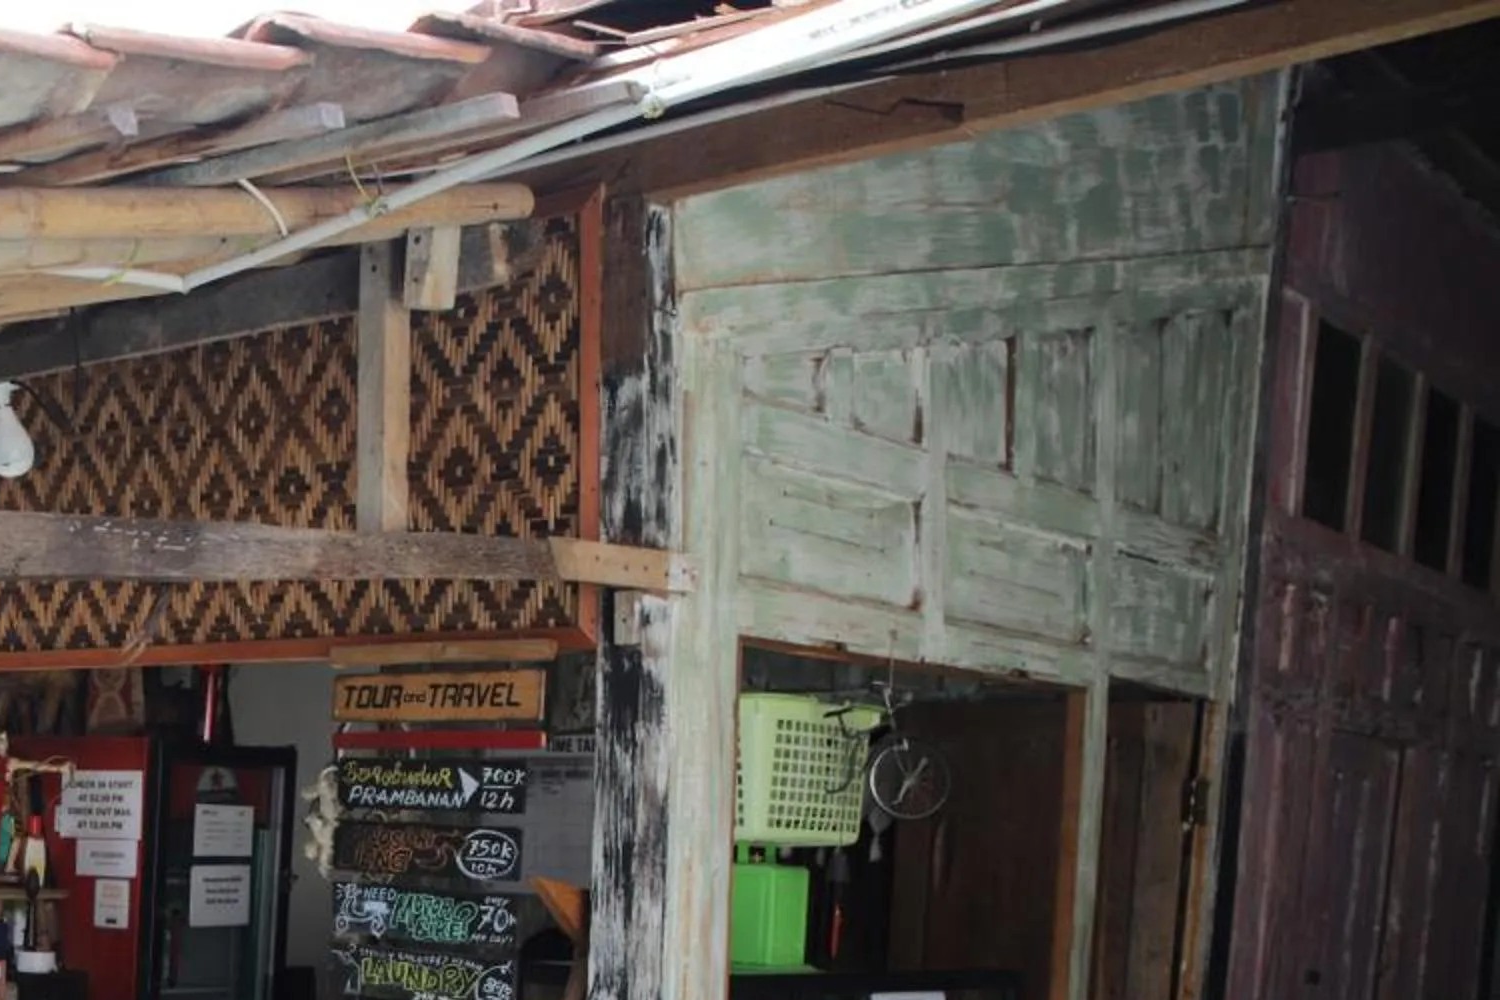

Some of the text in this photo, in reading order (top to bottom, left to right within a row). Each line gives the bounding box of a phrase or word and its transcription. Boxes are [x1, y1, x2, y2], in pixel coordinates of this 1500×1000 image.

[343, 682, 522, 709] TOUR and TRAVEL
[348, 785, 467, 810] PRAMBANAN
[363, 887, 396, 900] NEED
[361, 957, 483, 999] LAUNDRY
